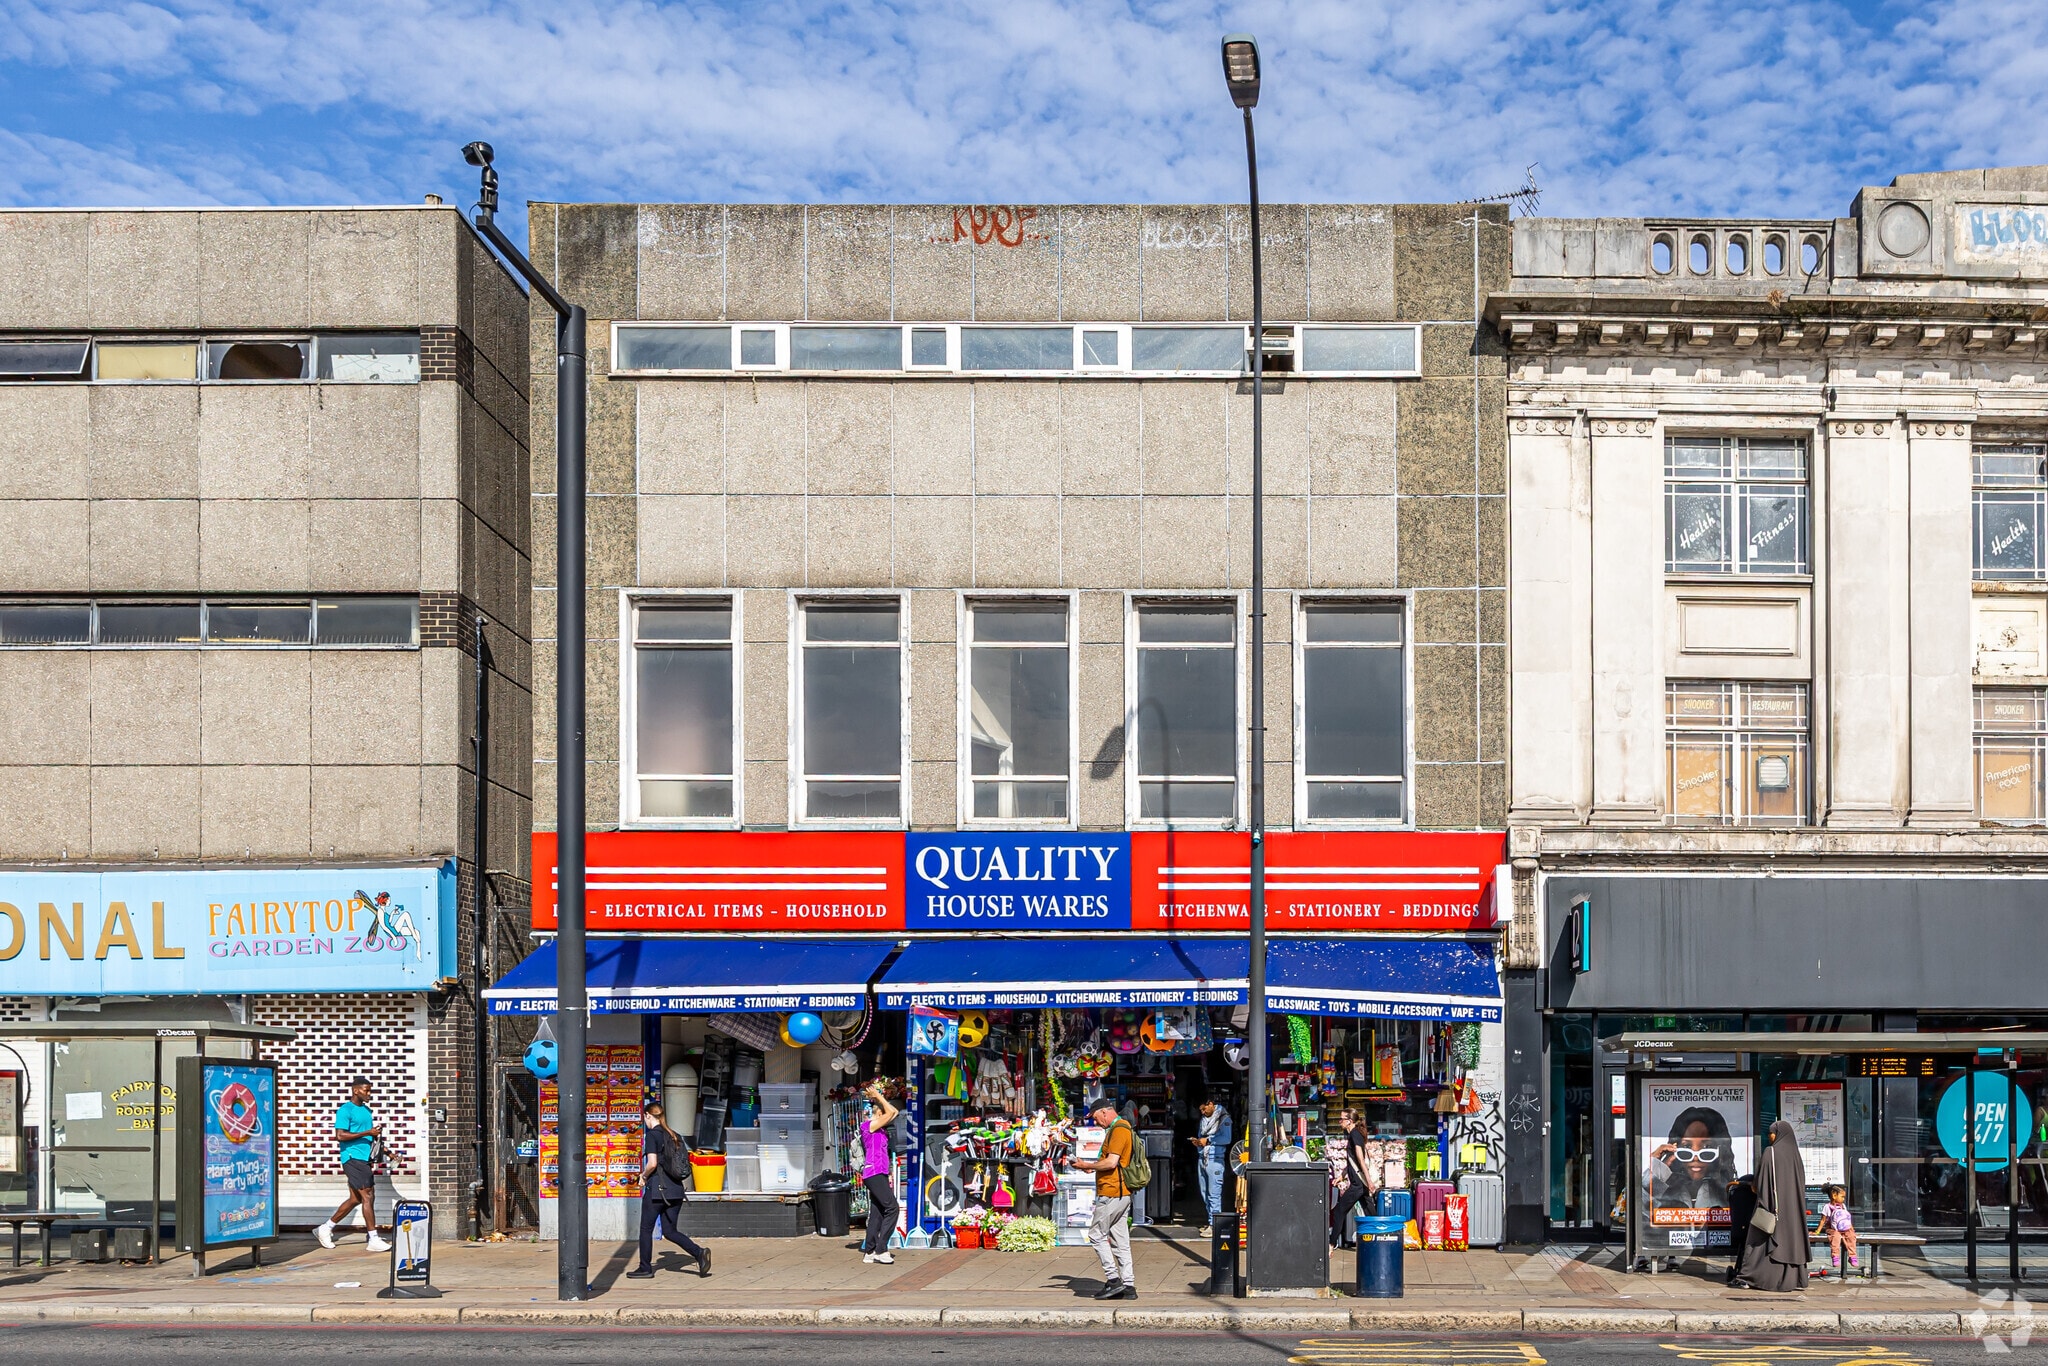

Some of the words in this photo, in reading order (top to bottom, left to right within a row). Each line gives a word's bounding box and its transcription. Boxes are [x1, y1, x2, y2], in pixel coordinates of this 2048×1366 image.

[1680, 513, 1716, 549] Health
[1752, 513, 1795, 547] Fitness
[1991, 519, 2027, 556] Health
[1684, 700, 1715, 709] SNOOKER
[1752, 700, 1793, 711] RESTAURANT
[1994, 705, 2024, 714] SNOOKER
[1678, 769, 1719, 789] Snooker
[1986, 763, 2031, 782] American
[1999, 776, 2022, 789] POOL
[915, 846, 1119, 889] QUALITY
[605, 904, 706, 917] ELECTRICAL
[714, 904, 763, 917] ITEMS
[786, 904, 887, 917] HOUSEHOLD
[926, 895, 1015, 918] HOUSE
[1021, 895, 1109, 918] WARES
[1158, 904, 1268, 917] KITCHENWAE
[1289, 904, 1382, 917] STATIONERY
[1403, 904, 1479, 917] BEDDINGS
[208, 898, 365, 936] FAIRYTOP
[208, 937, 333, 958] GARDEN
[344, 936, 407, 953] ZOO
[495, 1000, 513, 1011] DIY
[520, 1000, 558, 1011] ELECTRI
[605, 999, 660, 1010] HOUSEHOLD
[668, 998, 736, 1009] KITCHENWARE
[744, 997, 801, 1008] STATIONERY
[809, 996, 856, 1007] BEDDINGS
[887, 995, 903, 1006] DIY
[957, 994, 986, 1005] ITEMS
[994, 993, 1048, 1004] HOUSEHOLD
[1055, 992, 1122, 1004] KITCHENWARE
[1129, 992, 1185, 1003] STATIONERY
[1193, 991, 1239, 1002] BEDDINGS
[1267, 998, 1320, 1011] GLASSWARE
[1328, 1001, 1350, 1012] TOYS
[1357, 1002, 1390, 1015] MOBILE
[1392, 1004, 1444, 1017] ACCESSORY
[1451, 1006, 1474, 1018] VAPE
[1481, 1008, 1498, 1019] ETC
[110, 1081, 177, 1102] FAIRYO
[1653, 1088, 1715, 1096] FASHIONABLY
[1717, 1088, 1745, 1096] LATE?
[1963, 1103, 2007, 1122] PEN
[206, 1162, 235, 1179] Planet
[236, 1160, 259, 1173] Thing
[223, 1175, 246, 1190] Party
